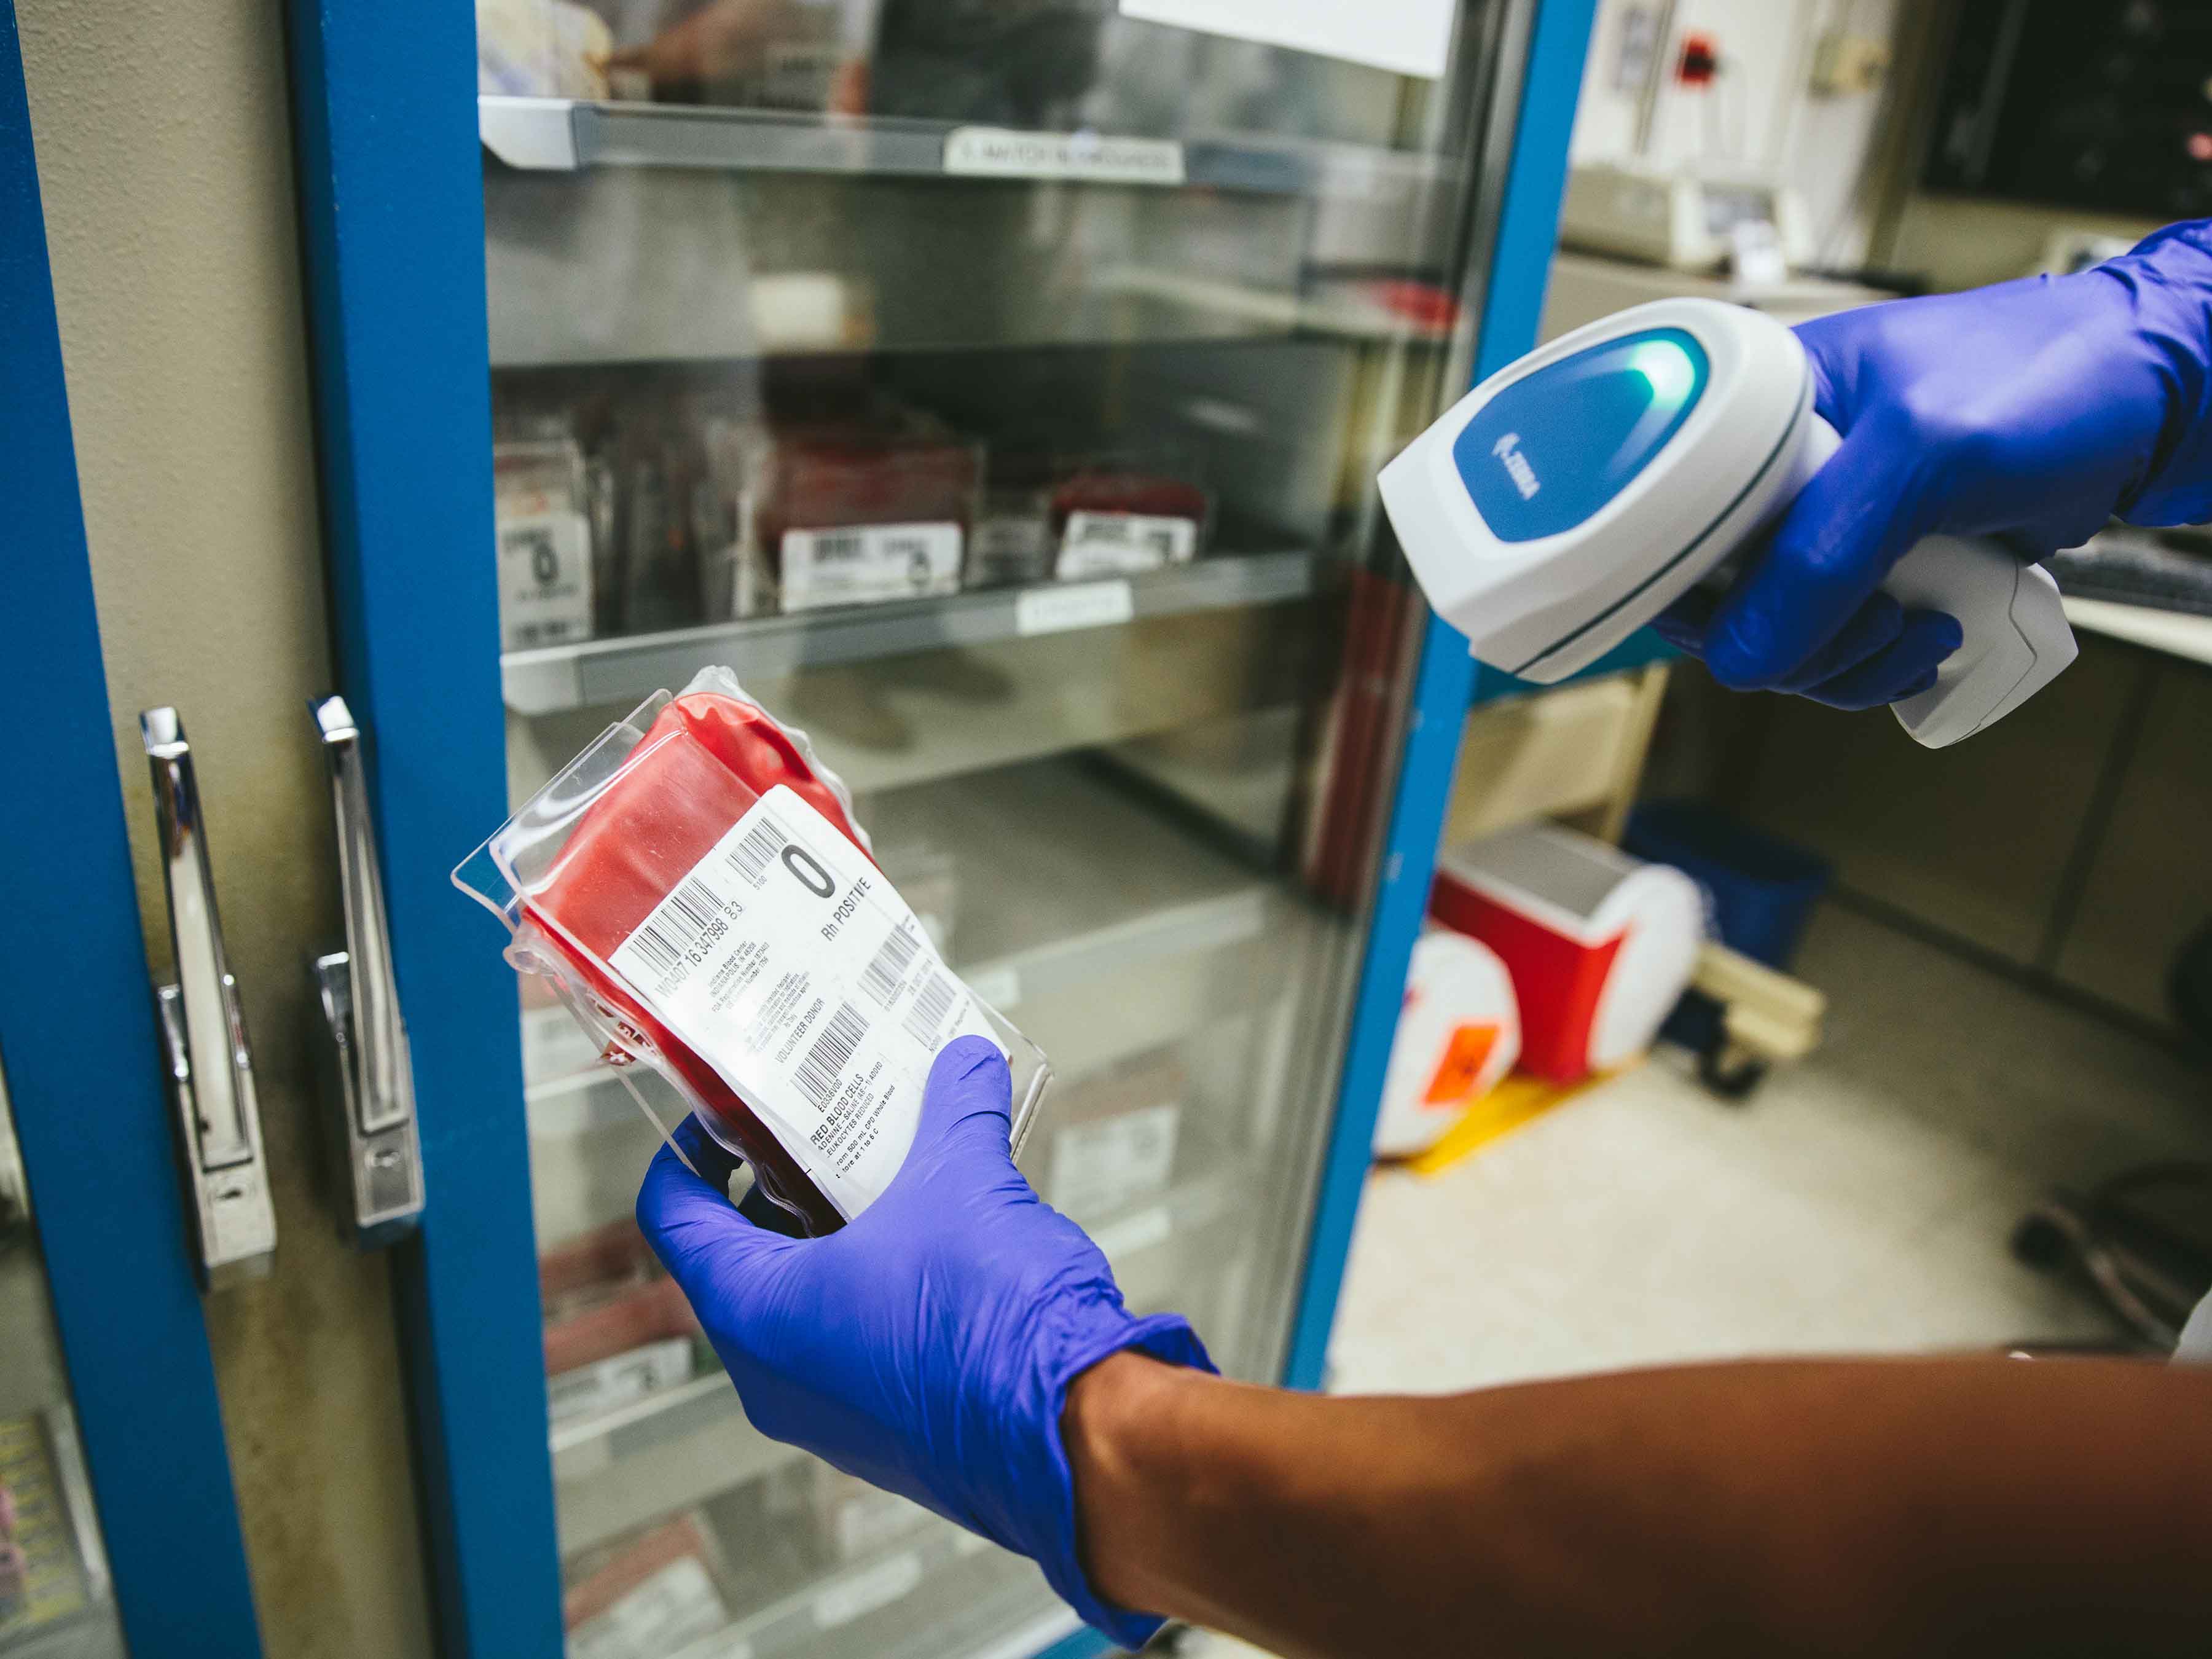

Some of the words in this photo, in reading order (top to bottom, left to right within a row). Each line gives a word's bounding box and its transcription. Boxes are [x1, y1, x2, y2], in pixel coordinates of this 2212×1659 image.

[753, 876, 767, 890] 5100
[781, 844, 836, 899] O
[821, 924, 839, 941] Rh
[833, 877, 871, 924] POSITIVE
[692, 918, 728, 955] 347998
[684, 949, 702, 967] 16
[723, 955, 736, 970] Blood
[655, 960, 690, 998] W0407
[775, 1021, 809, 1063] VOLUNTEER
[804, 998, 824, 1024] DONOR
[869, 1062, 882, 1080] ADDED
[810, 1124, 828, 1147] RED
[826, 1097, 849, 1126] BLOOD
[845, 1074, 863, 1098] CELLS
[847, 1140, 858, 1152] 500
[857, 1131, 867, 1141] mL
[865, 1116, 875, 1129] CPD
[873, 1100, 886, 1116] Whole
[884, 1084, 895, 1100] Blood
[855, 1093, 874, 1120] REDUCED
[854, 1151, 861, 1160] at
